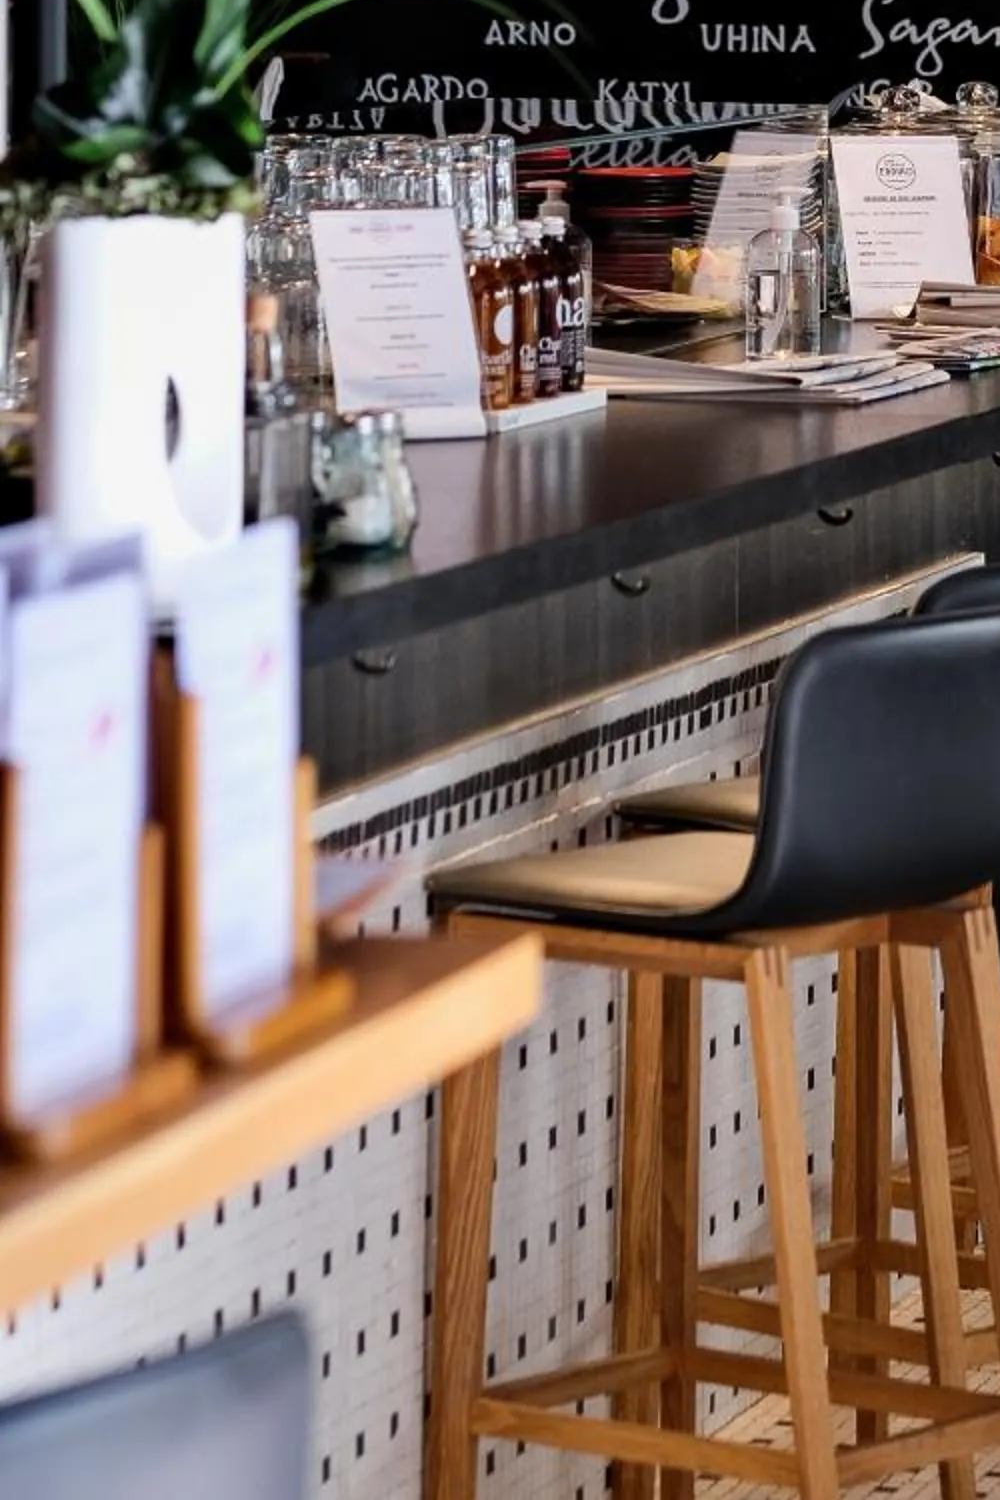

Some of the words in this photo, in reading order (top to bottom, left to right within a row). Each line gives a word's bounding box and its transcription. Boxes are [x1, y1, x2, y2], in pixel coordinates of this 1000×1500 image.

[485, 20, 577, 47] ARNO
[701, 24, 817, 52] UHINA
[598, 78, 692, 104] KATXI
